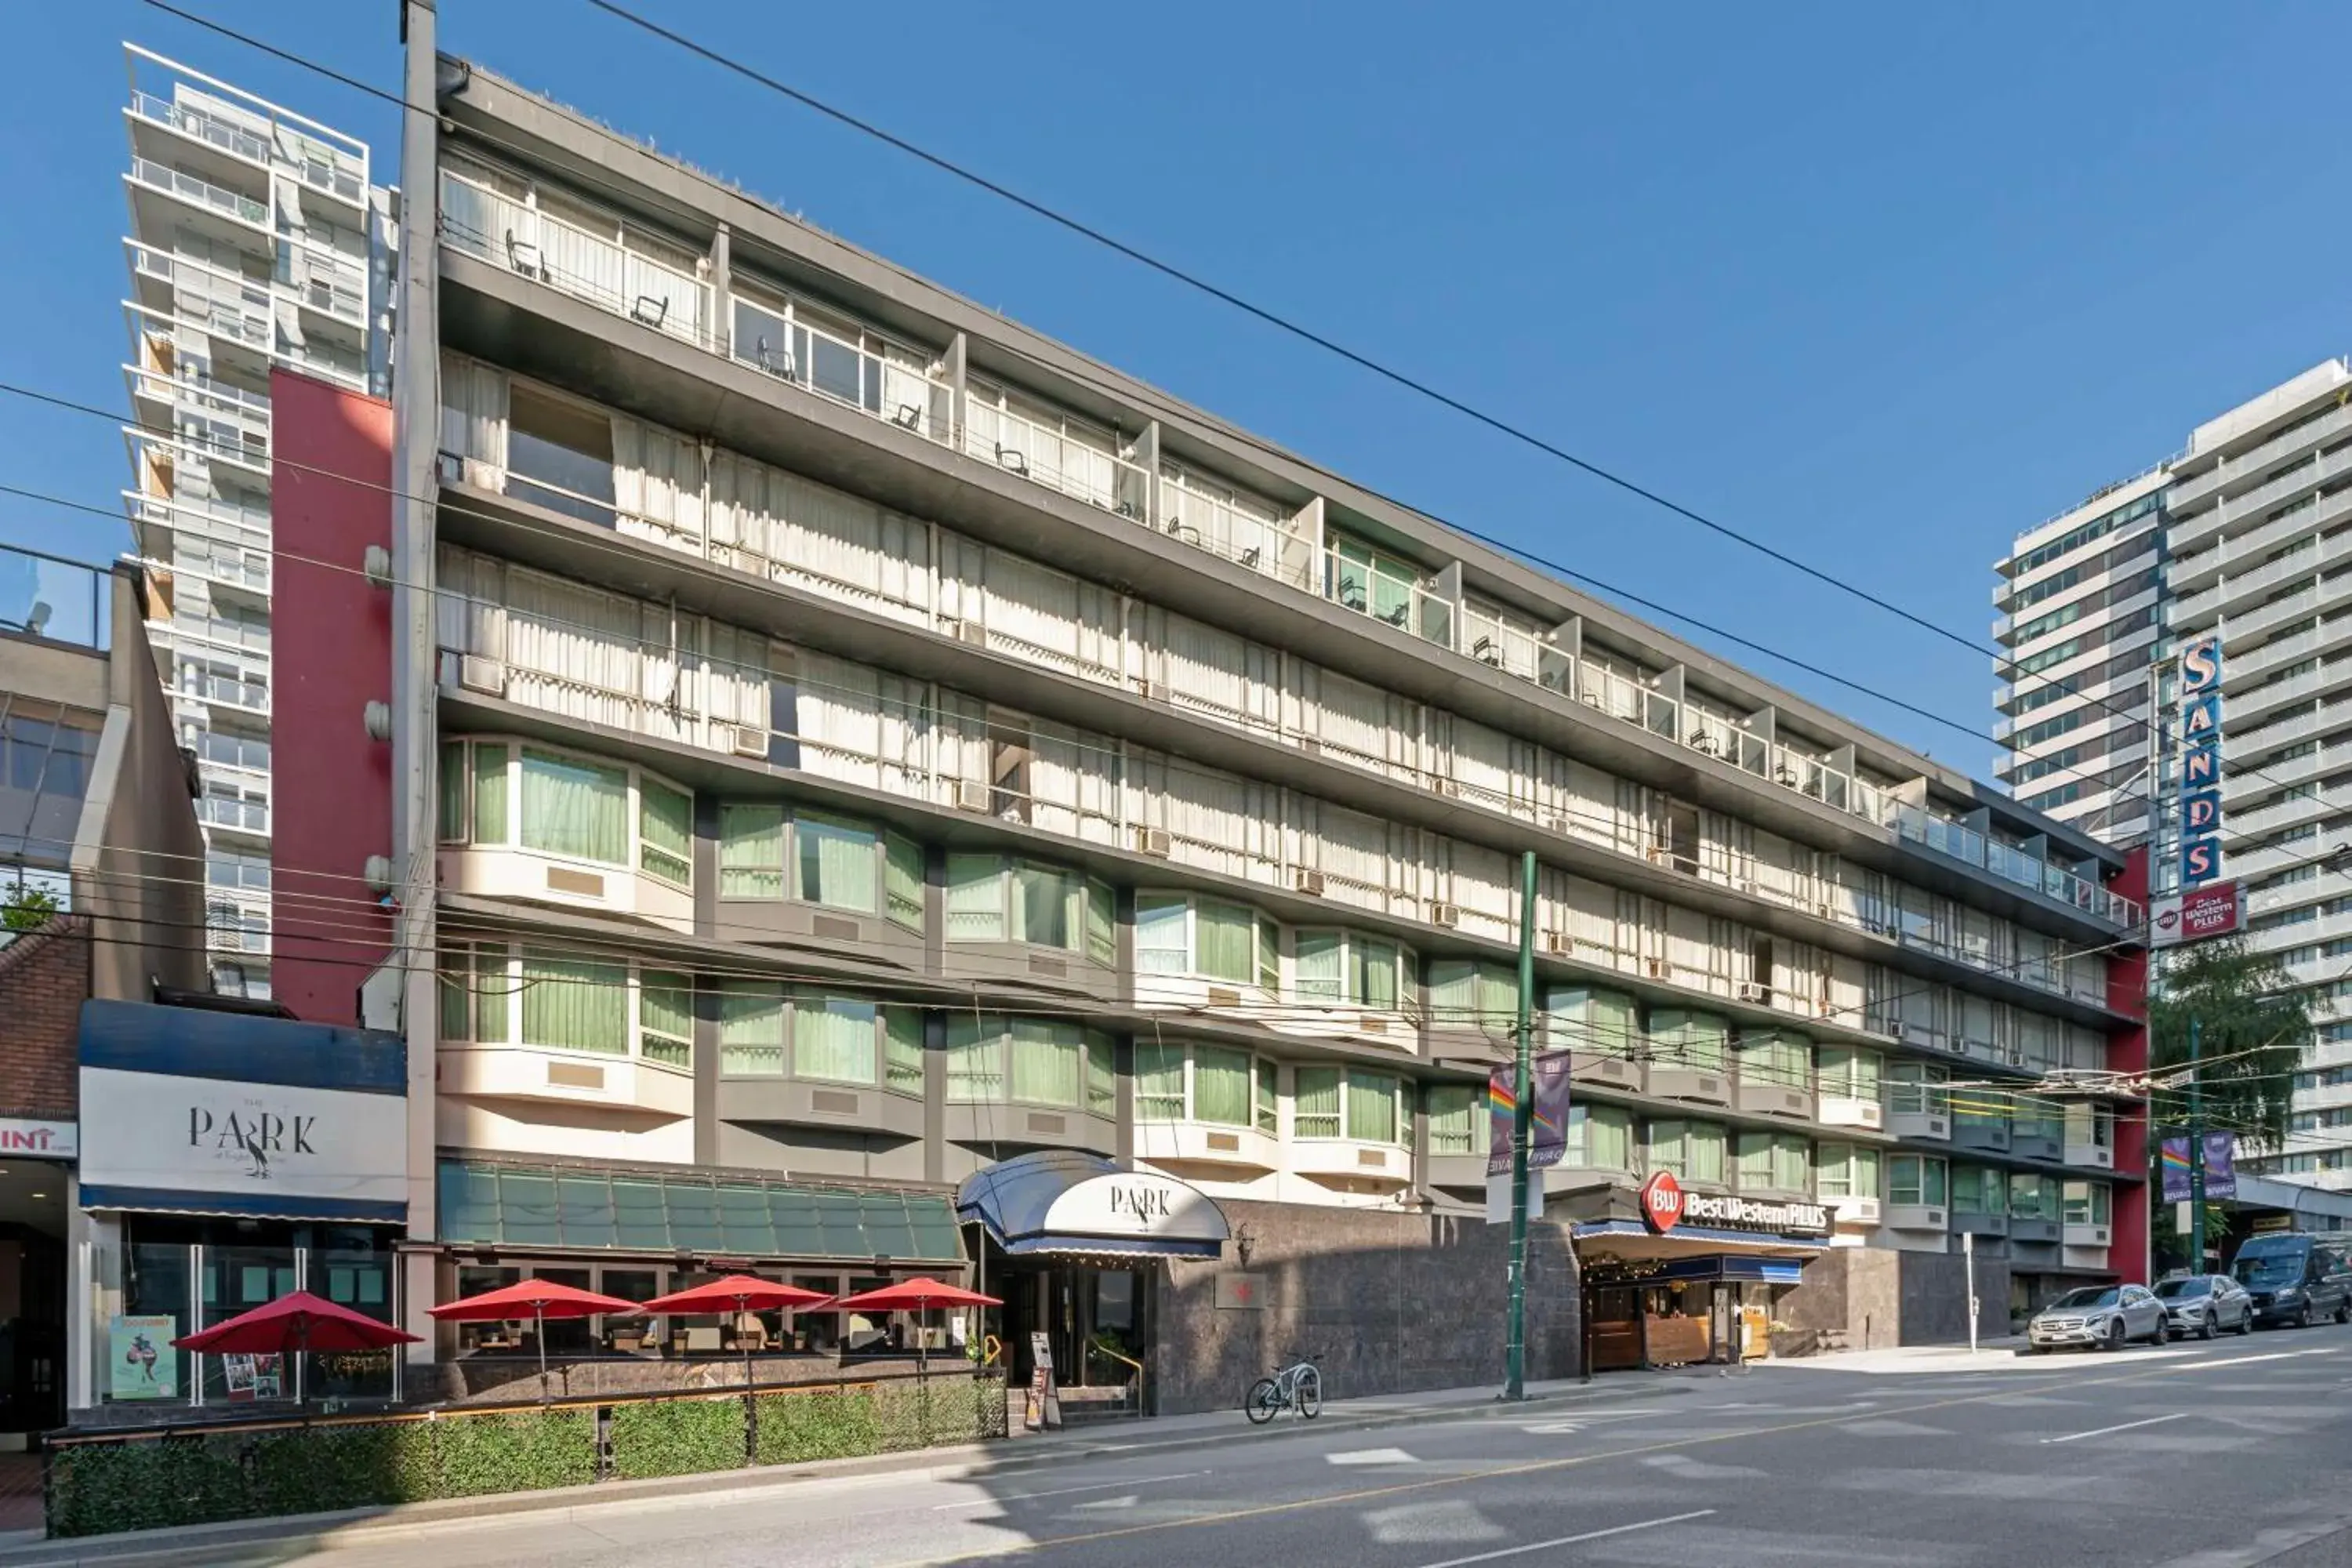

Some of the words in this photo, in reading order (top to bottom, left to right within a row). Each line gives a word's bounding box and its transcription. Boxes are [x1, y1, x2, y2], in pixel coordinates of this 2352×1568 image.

[2185, 639, 2216, 877] SANDS
[189, 1107, 317, 1155] PARK
[1111, 1185, 1170, 1215] PARK
[1653, 1189, 1679, 1211] BW
[1689, 1192, 1724, 1216] Best
[1726, 1197, 1787, 1225] Western
[1790, 1204, 1827, 1227] PLUS
